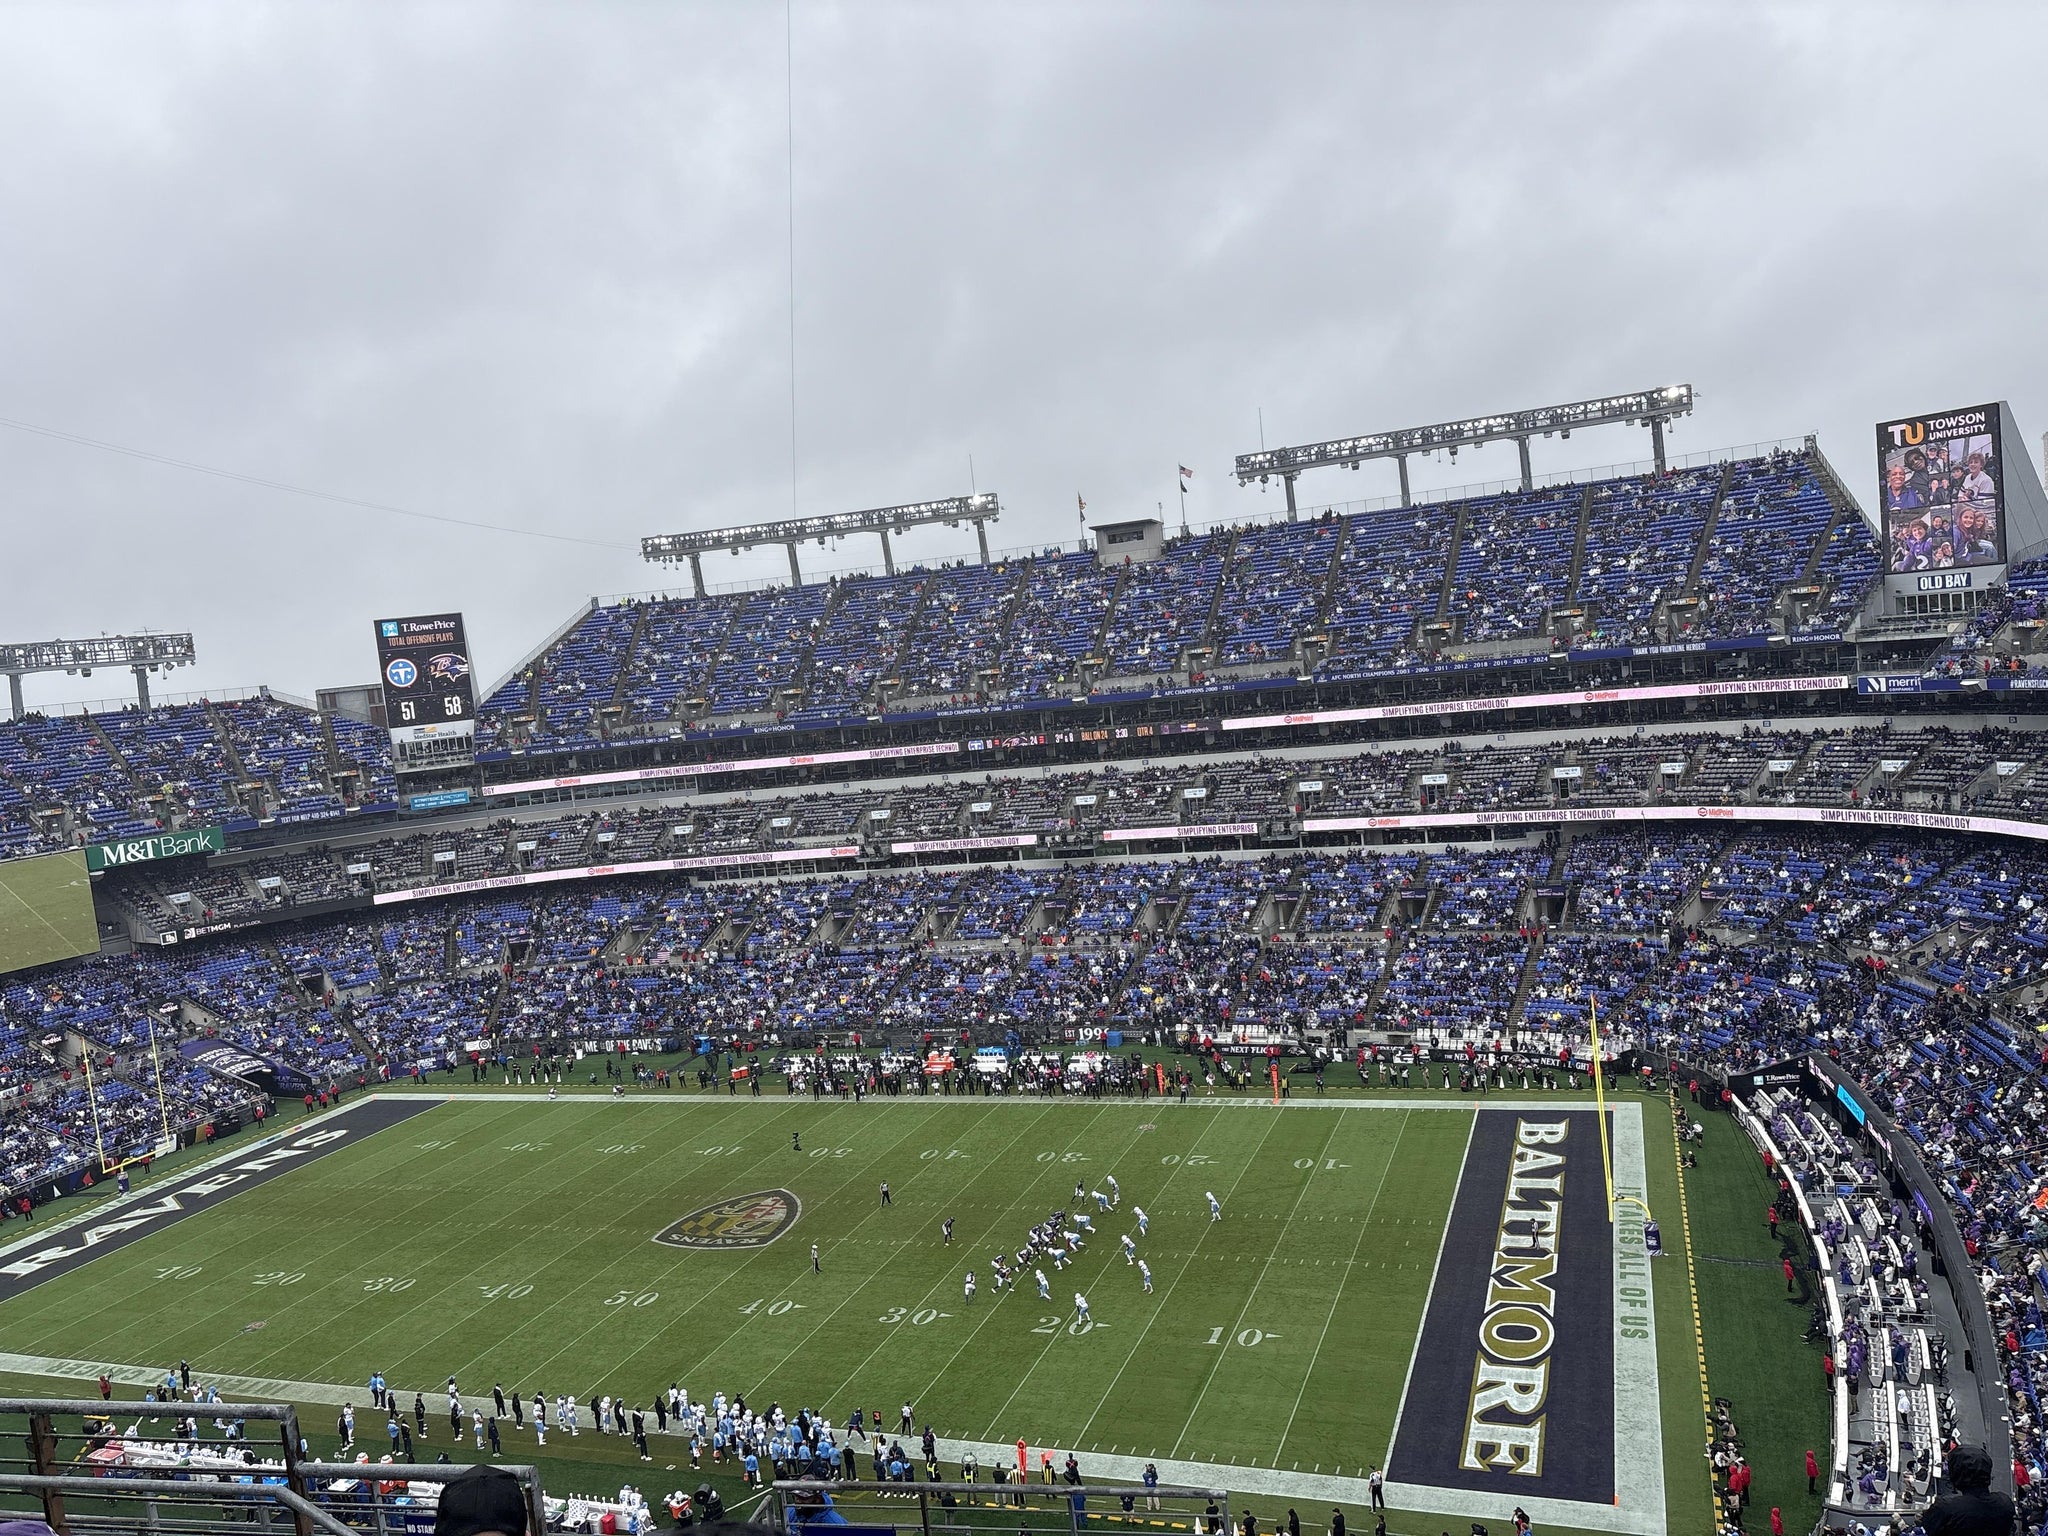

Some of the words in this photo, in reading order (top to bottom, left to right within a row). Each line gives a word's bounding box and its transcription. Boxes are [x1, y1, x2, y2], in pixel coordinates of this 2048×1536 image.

[1927, 411, 1985, 430] TOWSON
[1888, 422, 1924, 446] TU
[1929, 423, 1986, 441] UNIVERSITY
[1920, 576, 1942, 590] OLD
[1945, 573, 1968, 588] BAY
[388, 636, 406, 647] TOTAL
[407, 634, 435, 645] OFFENSIVE
[436, 632, 454, 642] PLAYS
[1814, 634, 1841, 642] HONOR
[1660, 645, 1685, 653] FRONTLINE
[1686, 643, 1706, 651] HEROES!
[1699, 683, 1746, 694] SIMPLIFYING
[1748, 681, 1792, 692] ENTERPRISE
[1793, 678, 1843, 689] TECHNOLOGY
[401, 701, 415, 720] 51
[444, 696, 462, 716] 58
[1382, 704, 1424, 716] SIMPLIFYING
[1425, 702, 1465, 713] ENTERPRISE
[1466, 699, 1509, 710] TECHNOLOGY
[1081, 732, 1093, 741] BALL
[1100, 730, 1108, 739] 24
[1137, 727, 1148, 737] QTR
[1030, 736, 1038, 745] 24
[869, 749, 903, 759] SIMPLIFYING
[904, 746, 935, 756] ENTERPRISE
[639, 767, 672, 778] SIMPLIFYING
[673, 765, 703, 775] ENTERPRISE
[703, 763, 735, 773] TECHNOLOGY
[1477, 812, 1523, 823] SIMPLIFYING
[1525, 810, 1568, 821] ENTERPRISE
[1569, 808, 1616, 820] TECHNOLOGY
[1821, 809, 1872, 822] SIMPLIFYING
[1874, 811, 1919, 825] ENTERPRISE
[1921, 815, 1971, 829] TECHNOLOGY
[1177, 825, 1217, 836] SIMPLIFYING
[1218, 823, 1255, 834] ENTERPRISE
[101, 838, 159, 866] M&T
[160, 831, 213, 857] Bank
[913, 840, 948, 851] SIMPLIFYING
[949, 838, 982, 849] ENTERPRISE
[983, 836, 1019, 847] TECHNOLOGY
[673, 858, 707, 868] SIMPLIFYING
[708, 855, 739, 865] ENTERPRISE
[739, 853, 773, 863] TECHNOLOGY
[412, 885, 452, 898] SIMPLIFYING
[453, 880, 488, 892] ENTERPRISE
[489, 876, 526, 887] TECHNOLOGY
[196, 922, 231, 936] BETMGM
[1065, 1030, 1075, 1040] EST
[605, 1041, 614, 1052] OF
[1230, 1046, 1249, 1054] NEXT
[1541, 1057, 1560, 1067] NEXT
[0, 1129, 348, 1280] RAVENS
[668, 1233, 762, 1245] RAVENS
[153, 1266, 202, 1280] 10
[1618, 1249, 1645, 1281] ALL
[252, 1271, 306, 1286] 20
[364, 1277, 416, 1293] 30
[482, 1283, 534, 1299] 40
[604, 1290, 660, 1307] 50
[1460, 1117, 1569, 1477] BALTIMORE
[1619, 1287, 1647, 1309] OF
[738, 1298, 793, 1316] 40
[879, 1307, 940, 1326] 30
[1031, 1316, 1094, 1336] 20
[1620, 1313, 1649, 1340] US
[1203, 1326, 1264, 1348] 10
[873, 1412, 881, 1420] 3
[407, 1524, 416, 1534] NO
